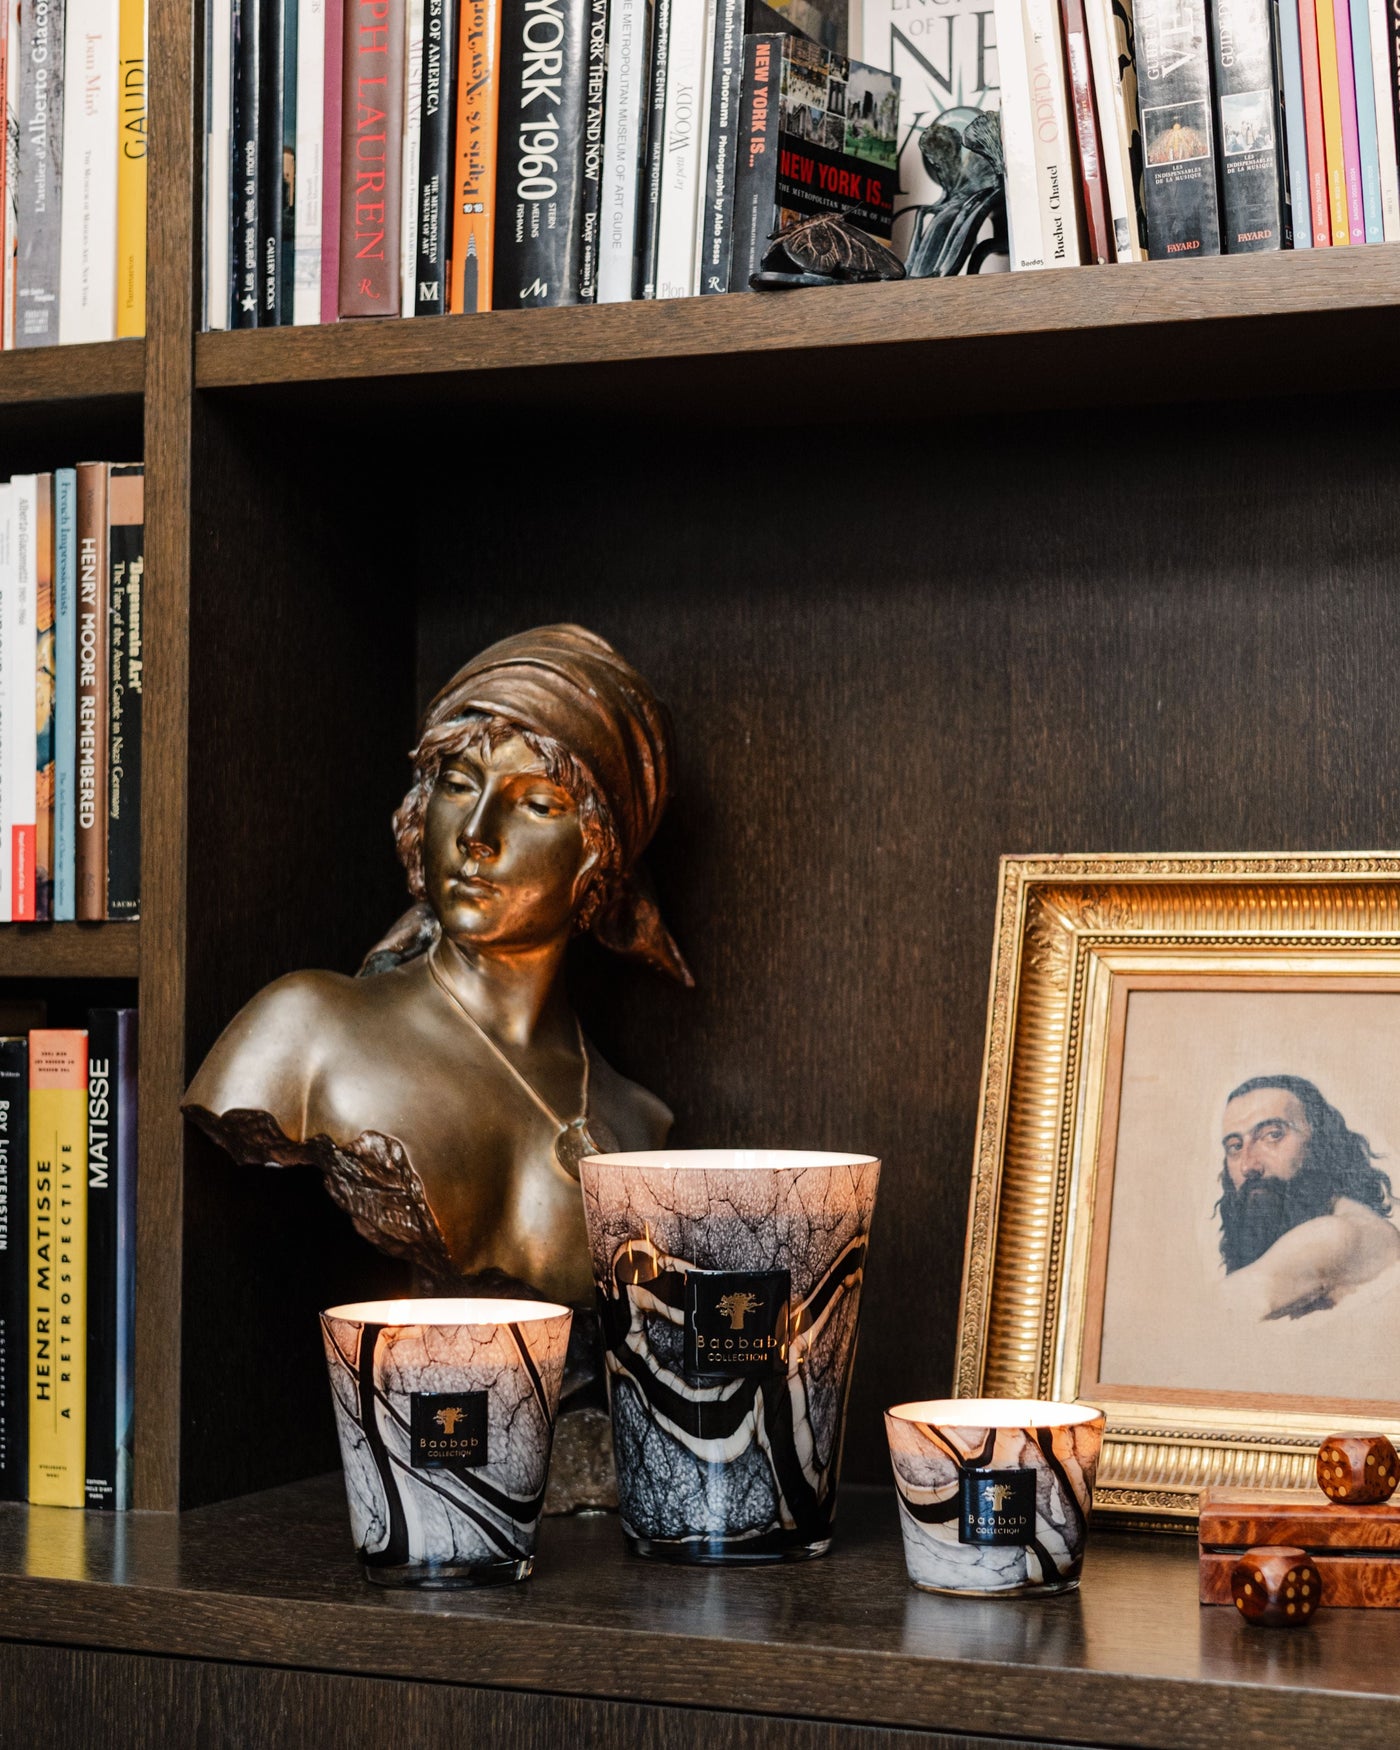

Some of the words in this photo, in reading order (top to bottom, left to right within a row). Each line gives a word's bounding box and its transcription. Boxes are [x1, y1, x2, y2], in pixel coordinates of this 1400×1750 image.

[31, 0, 49, 62] Giaco
[429, 19, 442, 41] OF
[468, 0, 484, 50] Yor
[659, 0, 670, 29] ORLD
[723, 0, 736, 65] Manhattan
[908, 18, 936, 36] OF
[86, 33, 102, 70] Joan
[521, 0, 565, 109] YORK
[590, 20, 605, 61] YORK
[618, 14, 632, 104] METROPOLITAN
[657, 32, 668, 66] TRADE
[427, 43, 441, 117] AMERICA
[466, 52, 491, 105] New
[754, 43, 771, 83] NEW
[588, 65, 604, 103] THEN
[654, 70, 666, 110] CENTER
[719, 68, 733, 128] Panorama
[119, 58, 148, 159] GAUDÍ
[466, 111, 481, 134] vs
[586, 107, 603, 141] AND
[669, 82, 693, 154] WOODY
[751, 87, 768, 133] YORK
[616, 109, 628, 161] MUSEUM
[652, 142, 661, 160] MAX
[748, 137, 766, 168] IS...
[246, 140, 256, 176] monde
[355, 74, 388, 261] LAUREN
[463, 141, 486, 196] Paris
[517, 113, 560, 200] 1960
[585, 144, 600, 181] NOW
[615, 165, 626, 185] OF
[715, 135, 728, 196] Photographs
[1154, 167, 1202, 180] INDISPENSABLES
[1226, 157, 1273, 169] INDISPENSABLES
[1246, 162, 1273, 172] MUSIQUE
[35, 161, 46, 213] L'atelier
[245, 180, 255, 195] du
[431, 175, 440, 193] THE
[650, 162, 660, 203] PROTETCH
[780, 149, 814, 185] NEW
[818, 163, 862, 200] YORK
[866, 177, 893, 210] IS...
[1046, 164, 1061, 210] Chastel
[1175, 172, 1202, 182] MUSIQUE
[244, 199, 255, 223] villes
[423, 184, 431, 223] MUSEUM
[548, 203, 557, 229] STERN
[614, 185, 625, 211] ART
[714, 199, 725, 211] by
[778, 182, 791, 192] THE
[792, 184, 840, 209] METROPOLITAN
[869, 211, 878, 221] OF
[879, 214, 892, 225] ART
[422, 225, 429, 235] OF
[429, 194, 439, 264] METROPOLITAN
[515, 203, 525, 243] FISHMAN
[530, 203, 540, 238] MELLINS
[581, 212, 597, 242] Dover
[612, 213, 624, 249] GUIDE
[714, 213, 724, 237] Aldo
[1053, 217, 1065, 260] Buchet
[1237, 229, 1272, 242] FAYARD
[246, 227, 256, 269] grandes
[266, 237, 276, 274] GALLERY
[421, 237, 429, 255] ART
[712, 238, 722, 265] Sessa
[1166, 240, 1200, 253] FAYARD
[244, 273, 254, 291] Les
[266, 277, 276, 310] BOOKS
[60, 482, 72, 525] French
[59, 529, 72, 616] Impressionists
[80, 538, 97, 607] HENRY
[113, 560, 126, 585] The
[113, 587, 125, 612] Fate
[112, 626, 125, 646] the
[113, 613, 125, 625] of
[80, 613, 97, 687] MOORE
[112, 648, 124, 719] Avant-Garde
[112, 722, 123, 733] in
[80, 695, 96, 830] REMEMBERED
[112, 737, 124, 763] Nazi
[110, 766, 124, 819] Germany
[89, 1058, 109, 1189] MATISSE
[37, 1161, 51, 1290] MATISSE
[61, 1145, 72, 1382] RETROSPECTIVE
[37, 1307, 50, 1400] HENRI
[697, 1334, 778, 1348] Baobab
[707, 1353, 767, 1361] COLLECTION
[61, 1408, 71, 1419] A
[420, 1438, 479, 1448] Baobab
[968, 1514, 1027, 1525] Baobab
[976, 1527, 1020, 1535] COLLECTION
